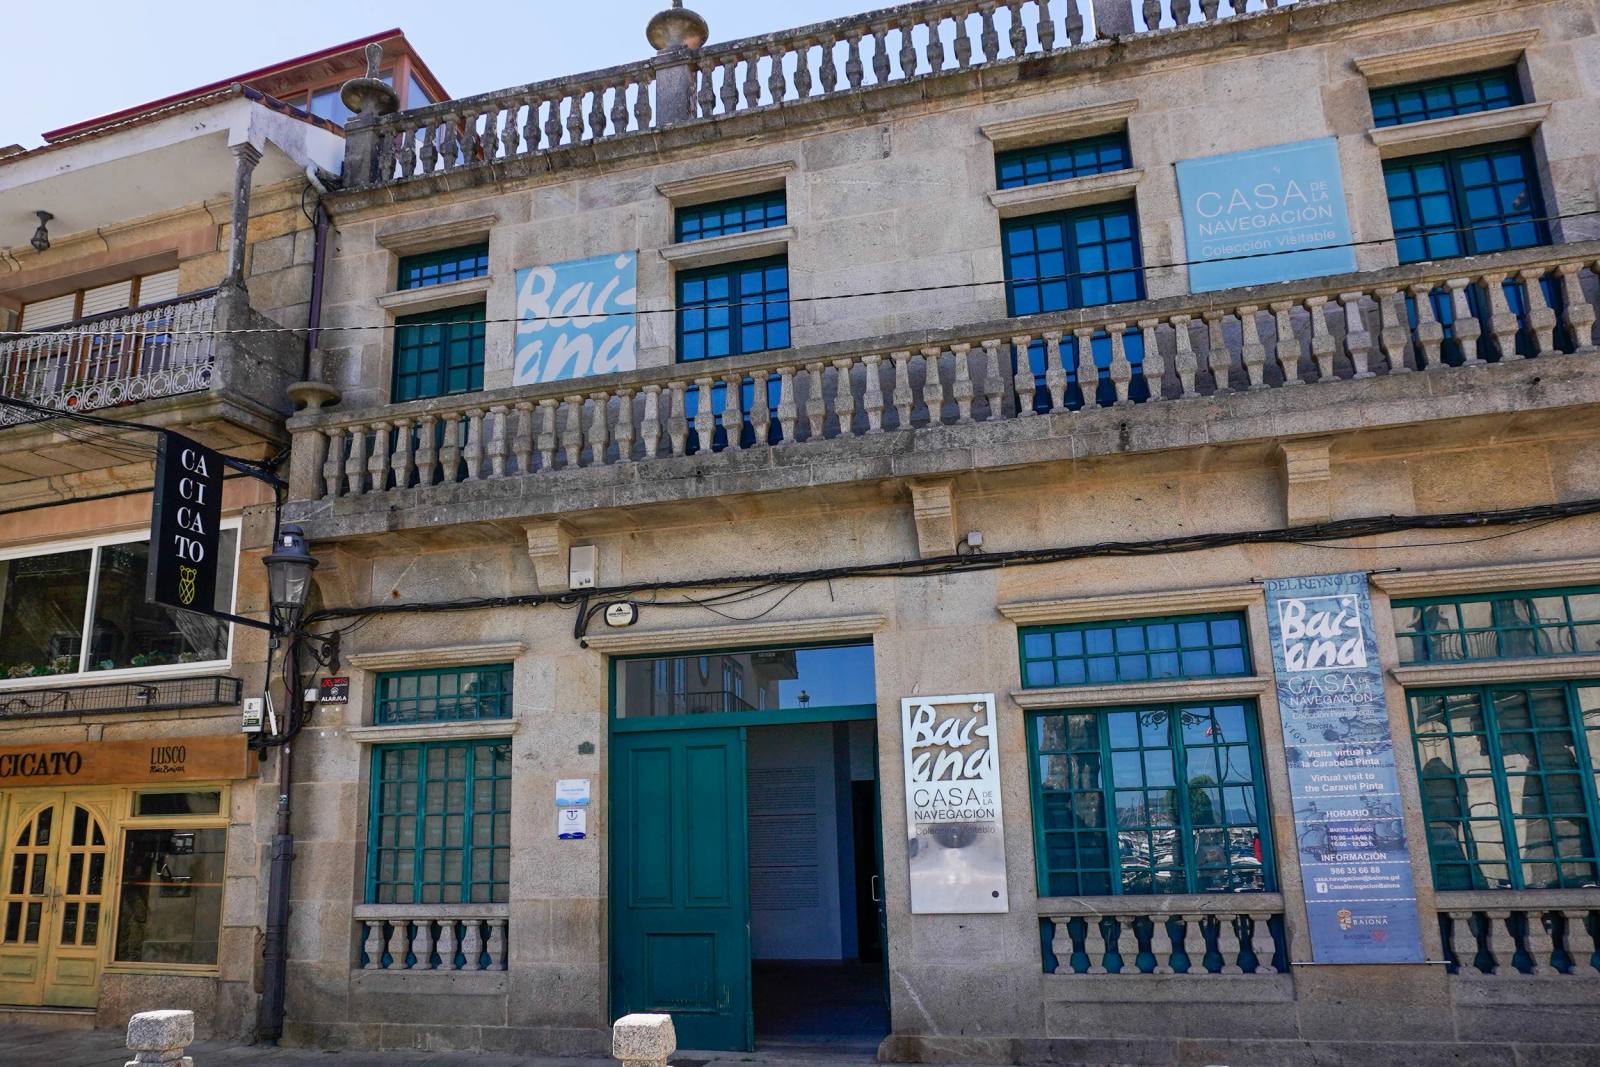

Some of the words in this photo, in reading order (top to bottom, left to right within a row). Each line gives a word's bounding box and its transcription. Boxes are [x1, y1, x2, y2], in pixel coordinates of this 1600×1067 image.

[1310, 181, 1328, 191] DE
[1196, 179, 1308, 218] CASA
[1312, 192, 1329, 202] LA
[1199, 204, 1333, 237] NAVEGACIÓN
[1201, 238, 1272, 257] Colección
[1277, 230, 1336, 246] Visitable
[181, 448, 210, 478] CA
[179, 477, 207, 506] CI
[176, 506, 206, 535] CA
[174, 534, 204, 563] TO
[1288, 674, 1358, 695] CASA
[151, 744, 186, 765] LUSCO
[1306, 749, 1332, 758] Visita
[1334, 748, 1363, 757] virtual
[1302, 760, 1310, 768] la
[1355, 757, 1380, 766] Pinta
[1311, 773, 1340, 782] Virtual
[1343, 773, 1363, 781] visit
[1305, 785, 1320, 793] the
[1322, 783, 1357, 792] Caravel
[1360, 782, 1384, 790] Pinta
[914, 787, 980, 808] CASA
[914, 807, 995, 821] NAVEGACIÓN
[1326, 809, 1369, 818] HORARIO
[1321, 852, 1387, 861] INFORMACIÓN
[1347, 866, 1357, 874] 35
